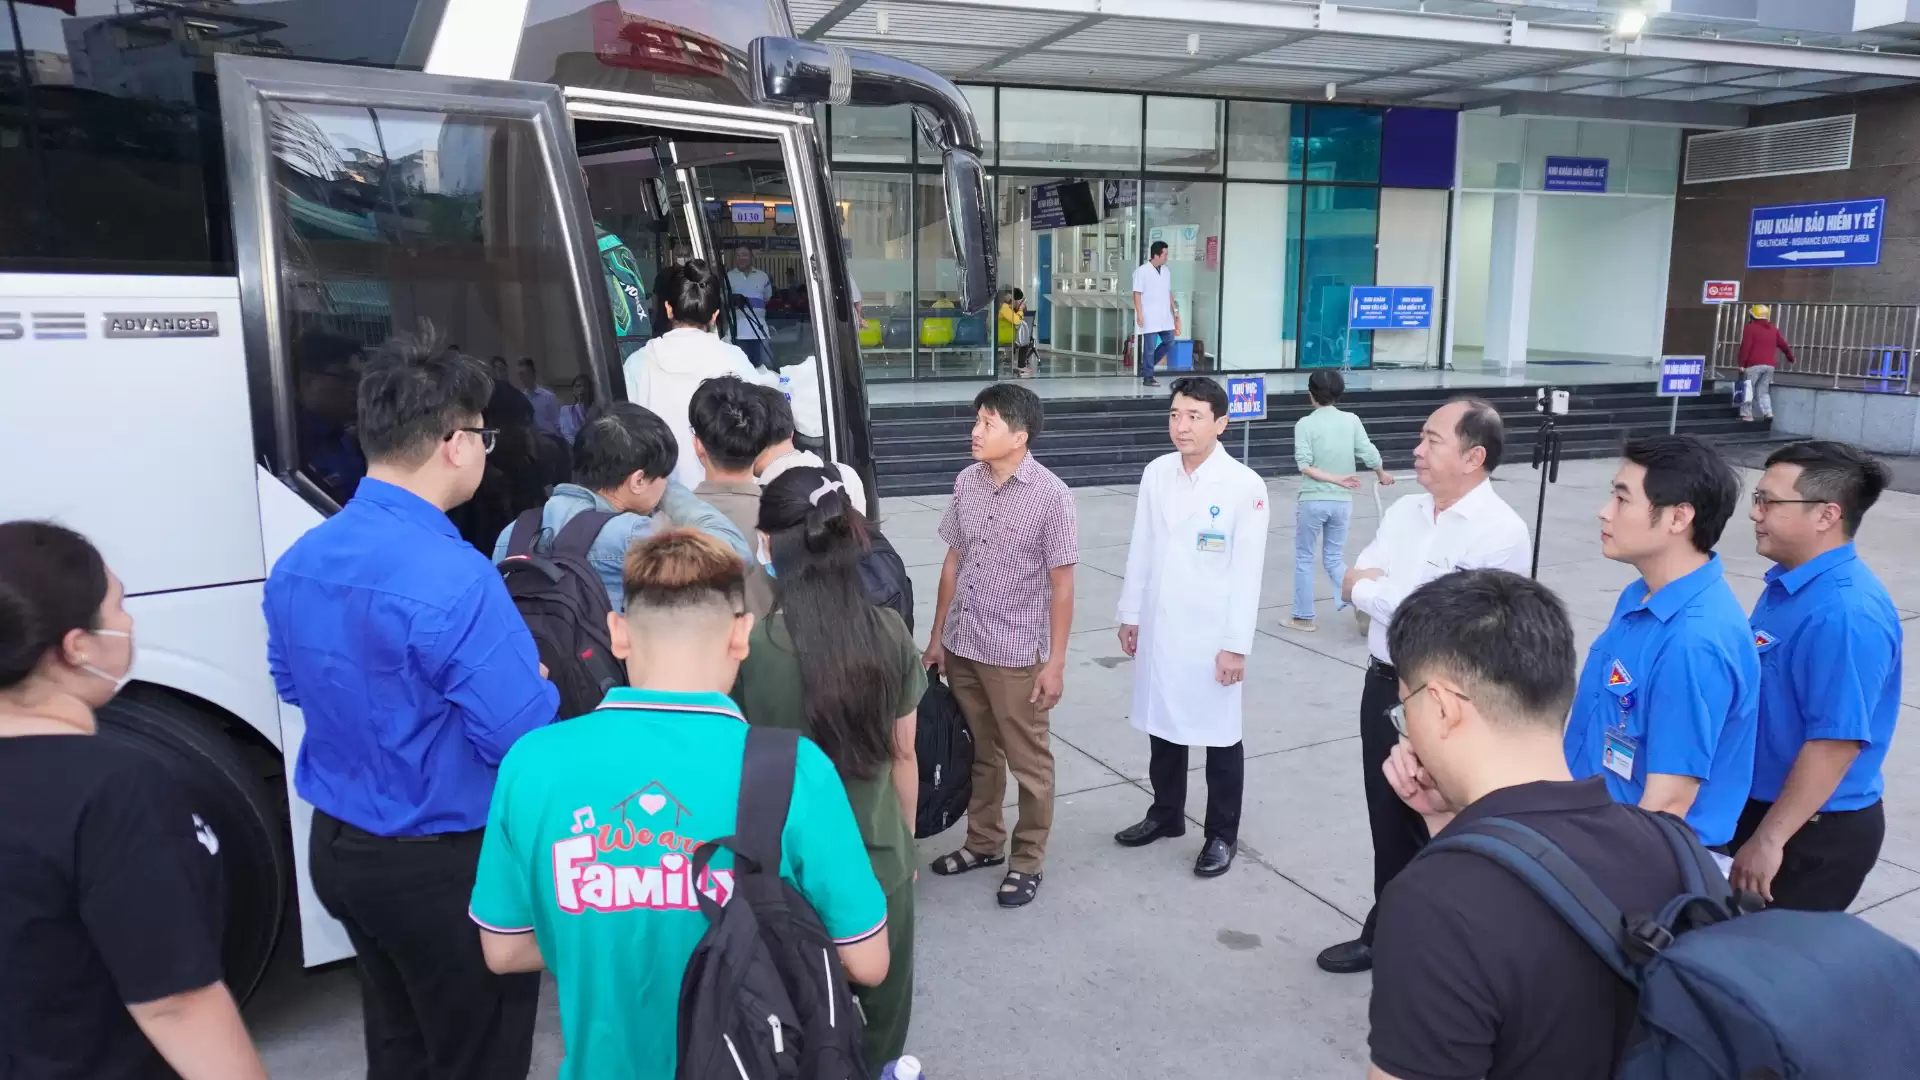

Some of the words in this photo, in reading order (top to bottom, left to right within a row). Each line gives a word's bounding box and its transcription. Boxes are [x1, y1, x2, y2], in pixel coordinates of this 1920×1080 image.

[737, 212, 758, 221] 0130
[1754, 219, 1774, 235] KHU
[1775, 214, 1803, 234] KHÁM
[1805, 211, 1825, 232] BẢO
[1826, 207, 1852, 231] HIỂM
[1854, 213, 1862, 229] Y
[1863, 206, 1878, 229] TẾ
[1757, 238, 1788, 248] HEALTHCARE
[1792, 236, 1820, 246] INSURANCE
[1822, 236, 1854, 244] OUTPATIENT
[1854, 234, 1870, 242] AREA
[111, 318, 212, 331] ADVANCED
[1232, 384, 1244, 394] KHU
[1230, 400, 1243, 413] CẤM
[1253, 401, 1260, 412] XE
[597, 820, 654, 852] We
[658, 831, 706, 854] are
